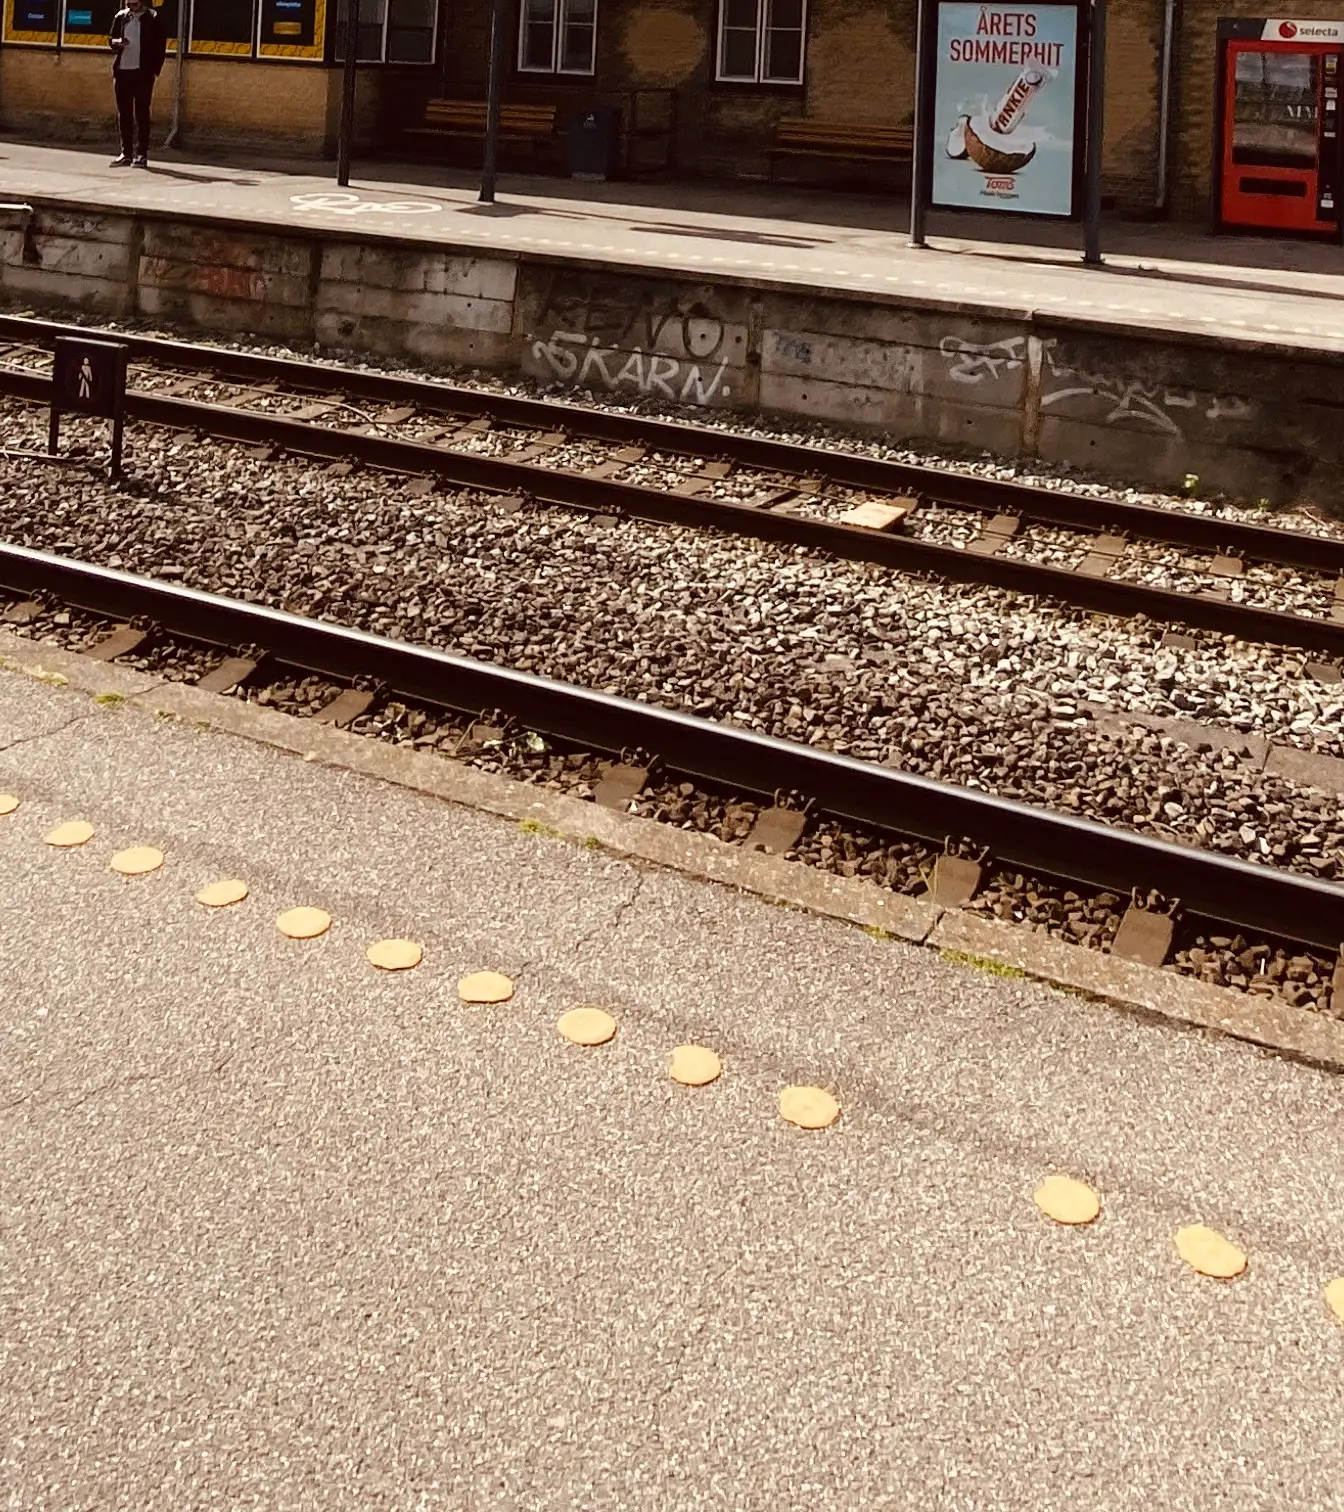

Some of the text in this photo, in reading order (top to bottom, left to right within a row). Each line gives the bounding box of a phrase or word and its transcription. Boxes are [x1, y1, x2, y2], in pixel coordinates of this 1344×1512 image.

[976, 5, 1037, 37] ÅRETS
[1299, 26, 1339, 37] selecta
[950, 39, 1064, 67] SOMMERHIT
